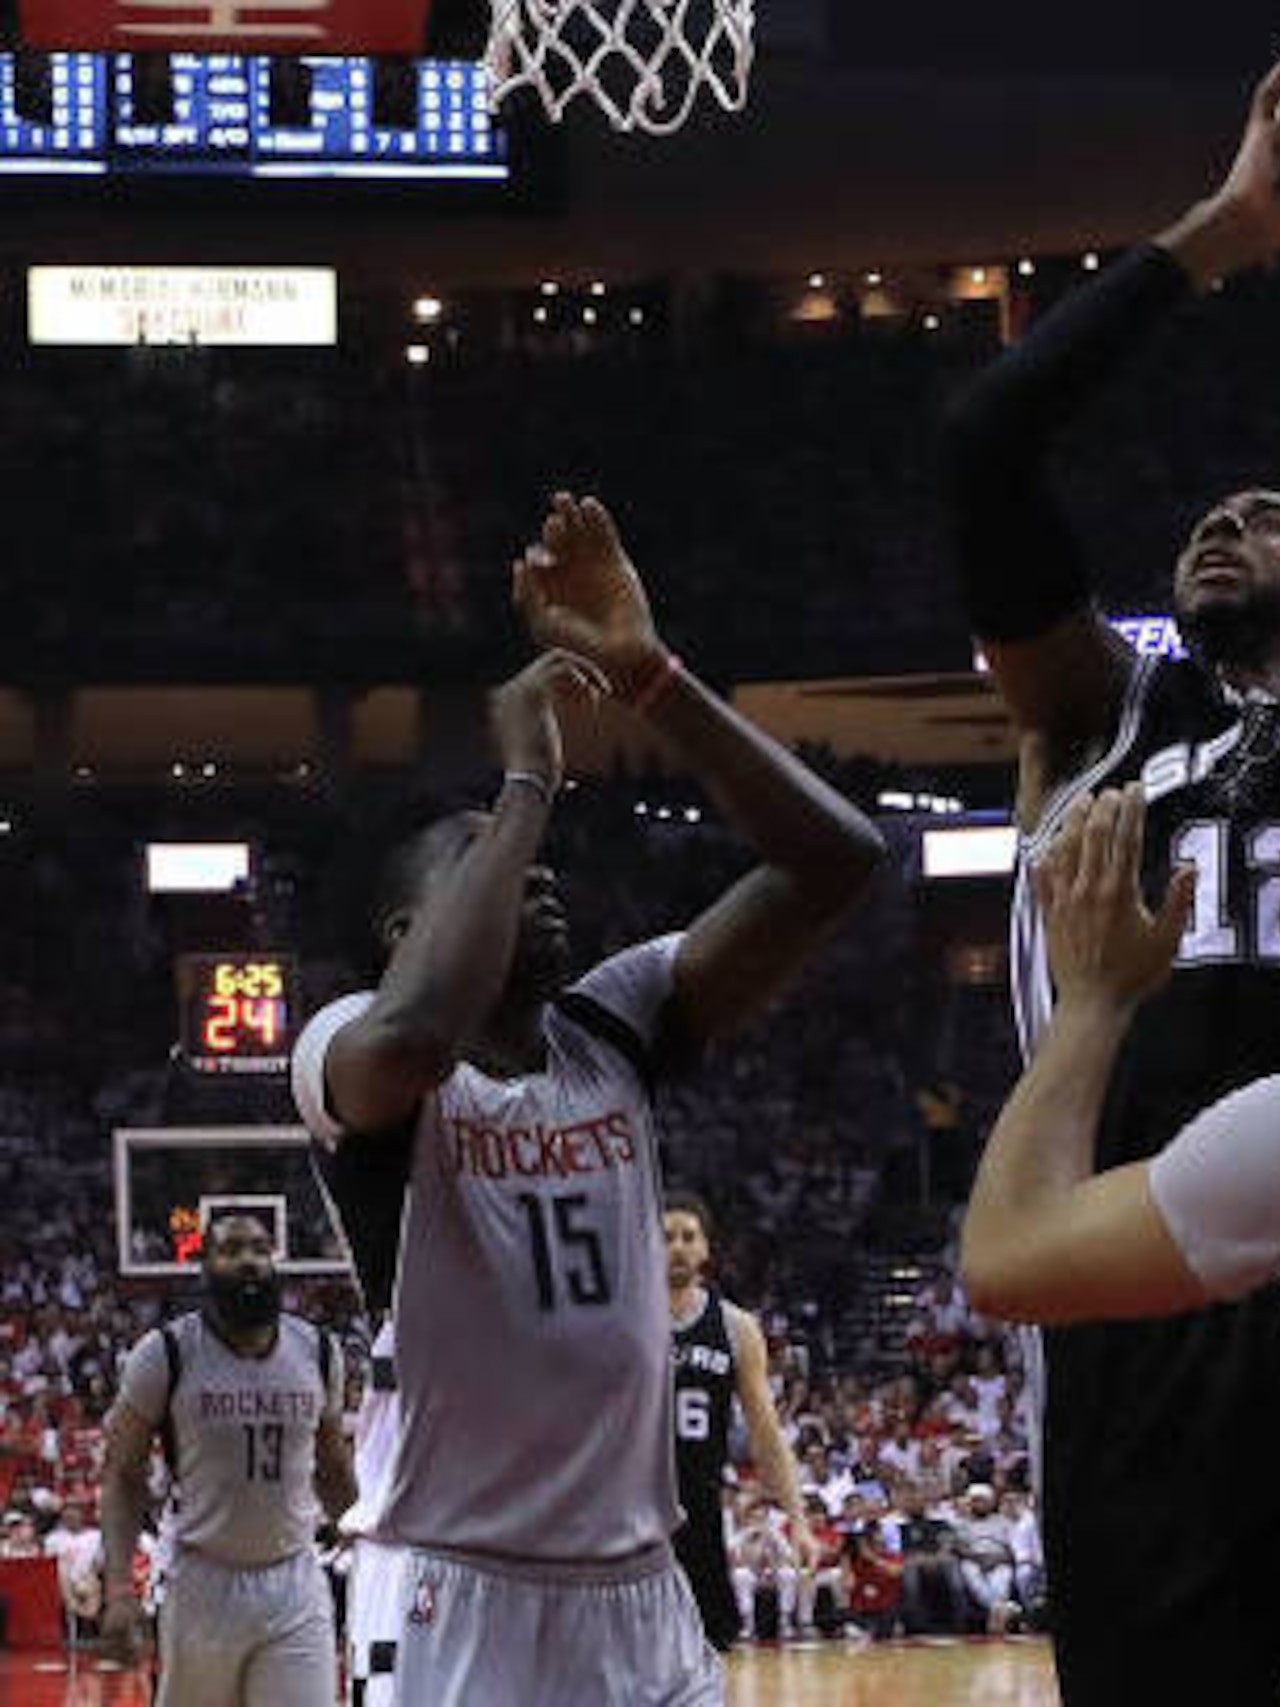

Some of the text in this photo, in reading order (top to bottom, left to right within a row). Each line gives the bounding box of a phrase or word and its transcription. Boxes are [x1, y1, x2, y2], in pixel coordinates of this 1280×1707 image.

[214, 963, 283, 998] 6:25
[206, 998, 277, 1049] 24
[452, 1110, 637, 1179] ROCKETS
[517, 1192, 611, 1312] 15
[201, 1388, 316, 1420] ROCKETS
[242, 1422, 284, 1482] 13
